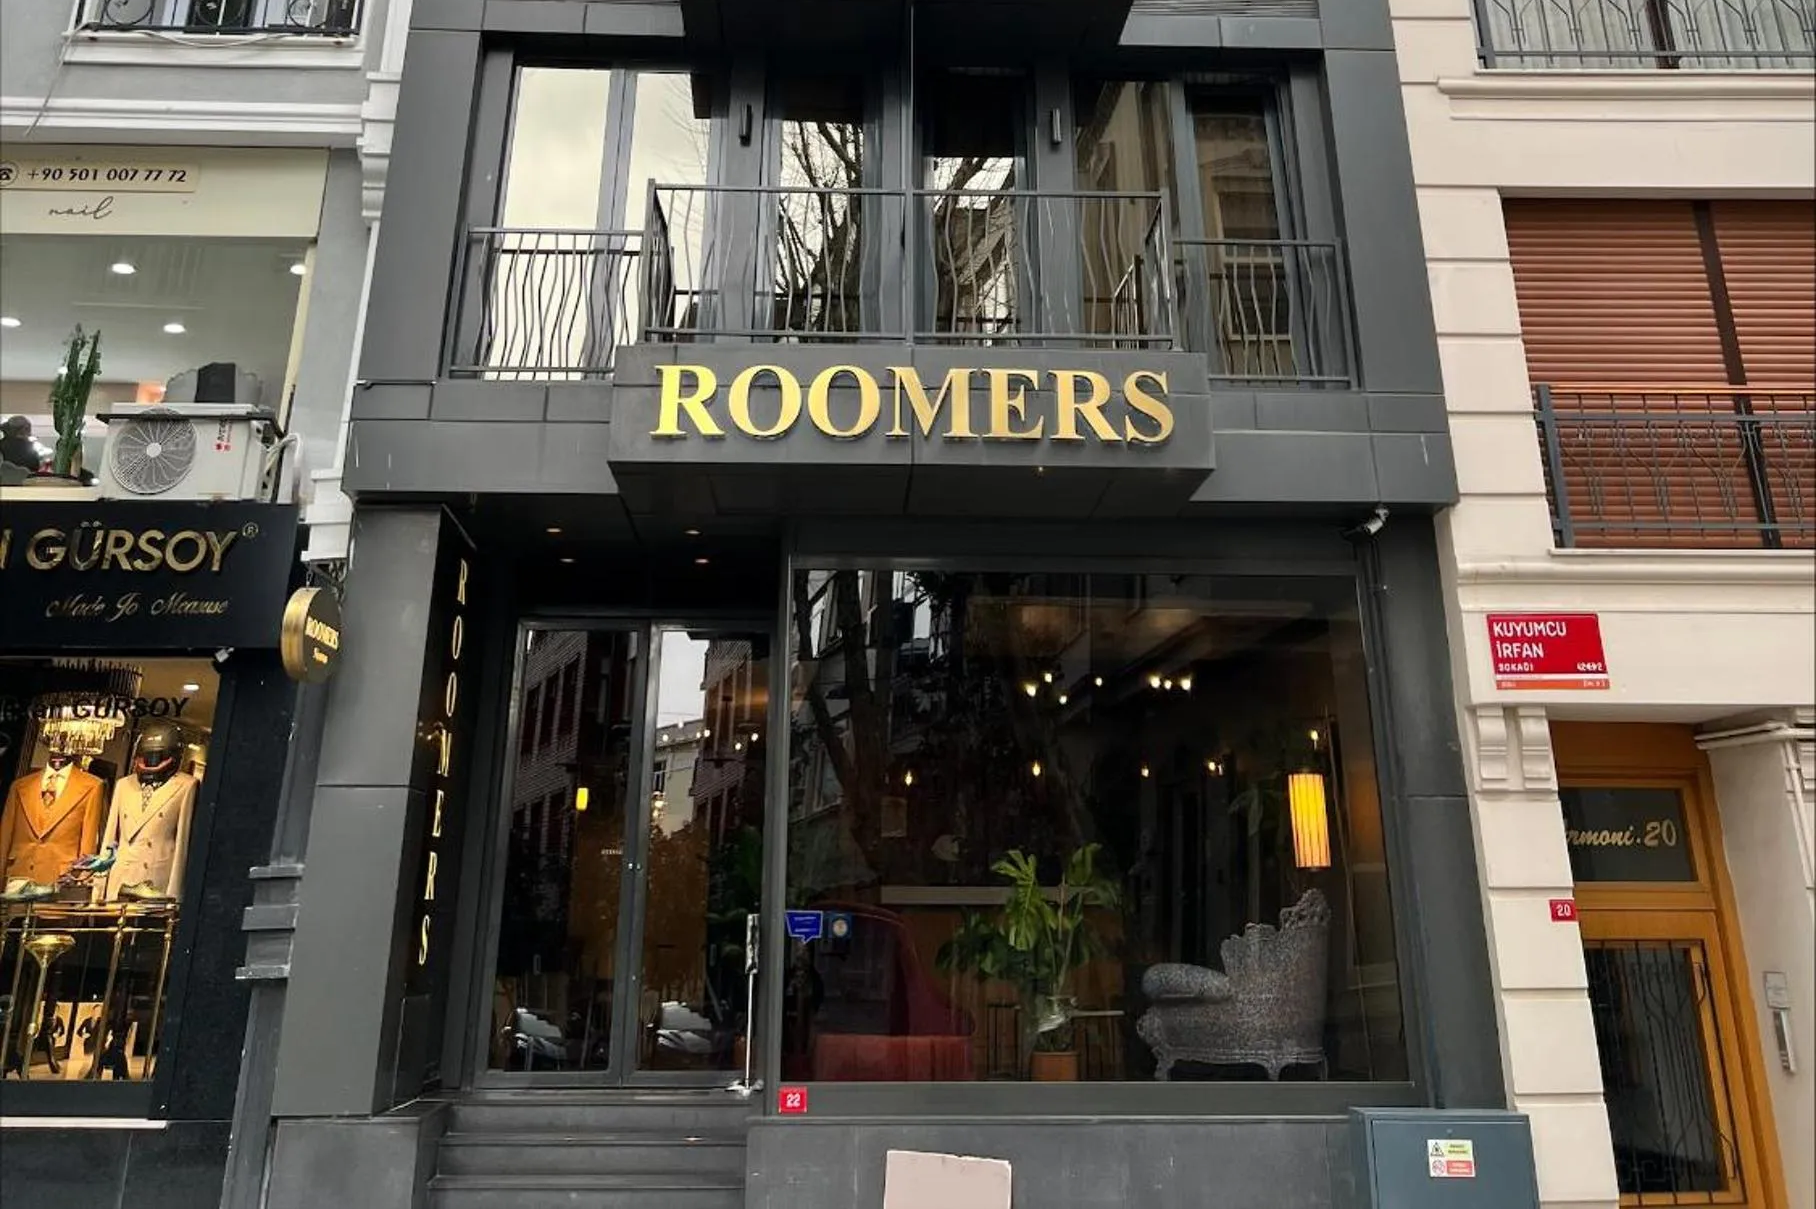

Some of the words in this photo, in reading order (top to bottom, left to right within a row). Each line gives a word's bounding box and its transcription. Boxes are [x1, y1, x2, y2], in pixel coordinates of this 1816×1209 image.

[28, 168, 63, 181] +90
[69, 168, 98, 181] 501
[106, 168, 139, 182] 007
[143, 169, 163, 182] 77
[167, 169, 187, 183] 72
[649, 363, 1175, 449] ROOMERS
[26, 520, 237, 572] GÜRSOY
[1492, 621, 1567, 637] KUYUMCU
[1495, 640, 1544, 658] İRFAN
[418, 557, 468, 966] ROOMERS
[1556, 903, 1572, 917] 20
[786, 1093, 801, 1108] 22
